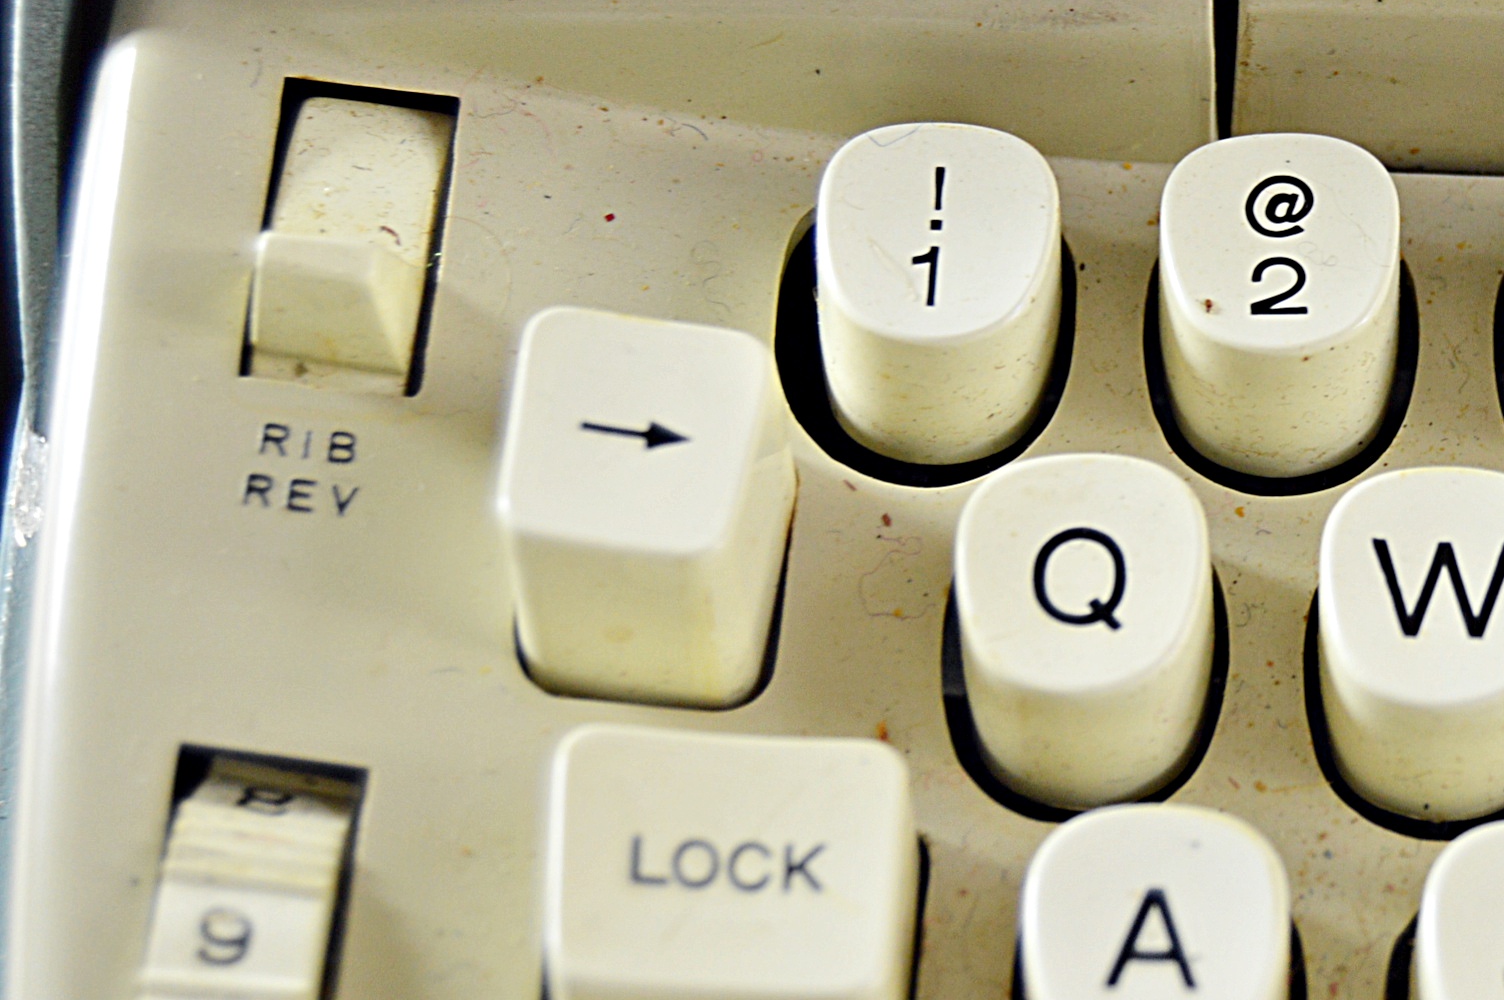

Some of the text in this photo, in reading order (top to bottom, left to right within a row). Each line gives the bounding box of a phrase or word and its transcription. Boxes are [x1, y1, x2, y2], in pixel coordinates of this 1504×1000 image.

[929, 166, 946, 231] !
[1244, 175, 1315, 238] @
[911, 245, 940, 307] 1
[1250, 256, 1308, 316] 2
[259, 422, 358, 465] RIB
[243, 473, 360, 517] REV
[1032, 527, 1127, 631] Q
[627, 834, 826, 894] LOCK
[196, 906, 253, 967] 9
[1105, 888, 1196, 989] A
